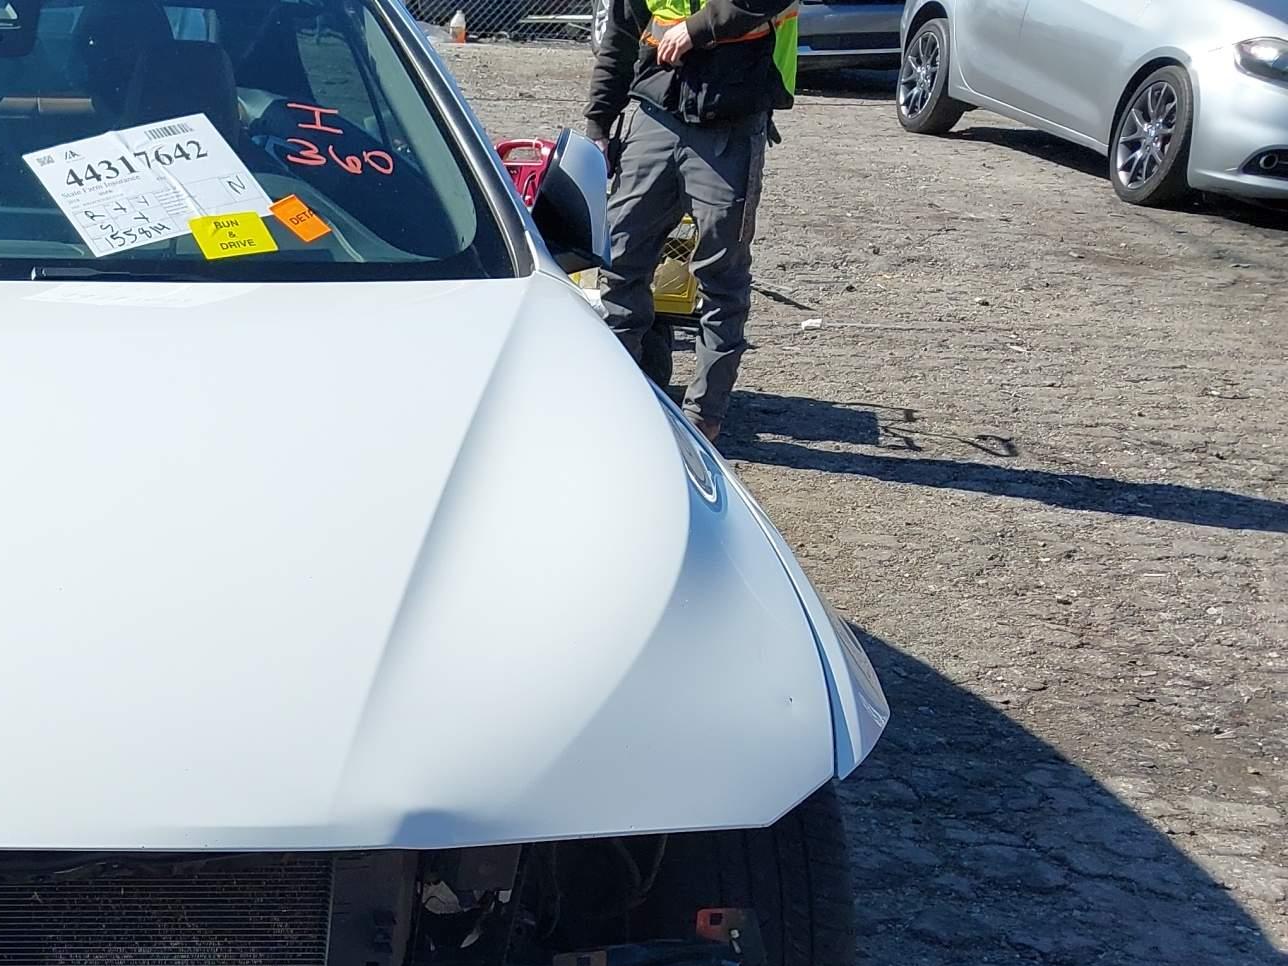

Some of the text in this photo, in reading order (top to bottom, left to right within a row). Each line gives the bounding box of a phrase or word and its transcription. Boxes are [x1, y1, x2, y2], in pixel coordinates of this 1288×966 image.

[287, 103, 344, 134] H
[66, 140, 208, 187] 44317642
[287, 138, 394, 174] 360
[220, 238, 256, 250] DRIVE
